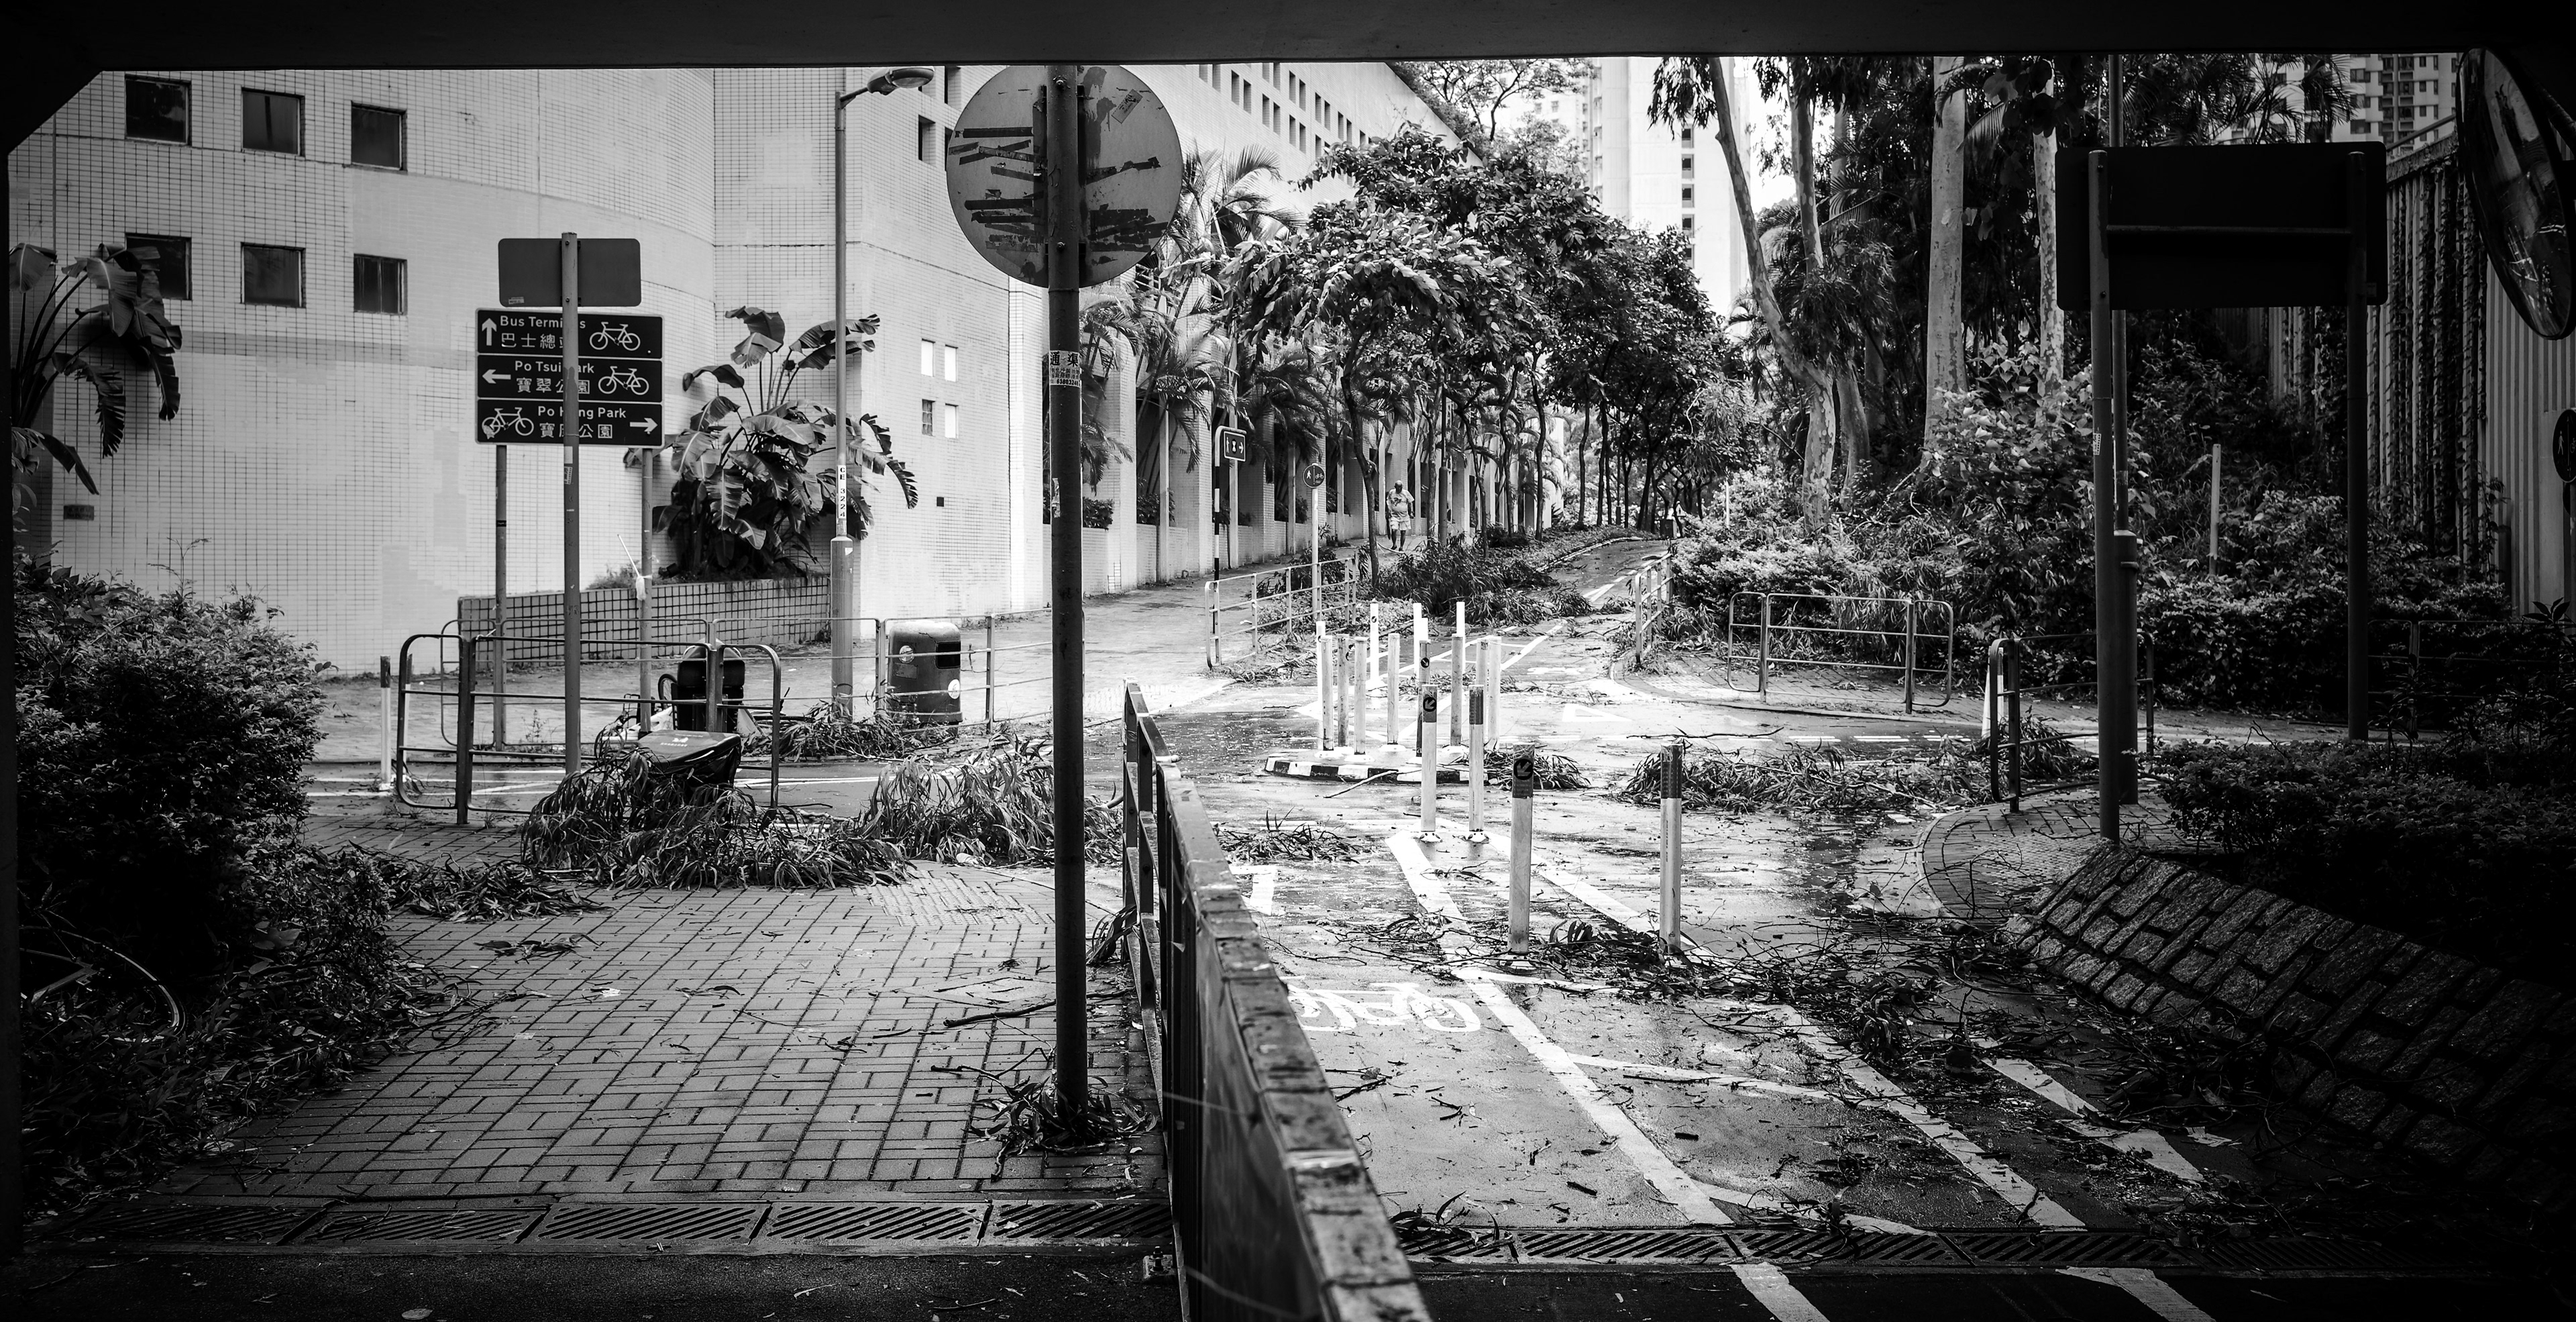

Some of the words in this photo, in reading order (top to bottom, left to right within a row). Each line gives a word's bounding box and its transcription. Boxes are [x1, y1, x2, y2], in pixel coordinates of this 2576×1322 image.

[500, 315, 525, 326] Bus
[528, 316, 586, 329] Termis
[501, 333, 563, 349] 巴士總
[1050, 350, 1078, 368] 通渠
[515, 360, 532, 371] Po
[535, 361, 561, 372] Tsui
[578, 362, 594, 373] ark
[538, 405, 555, 416] Po
[598, 407, 627, 418] Park
[839, 466, 846, 480] CE
